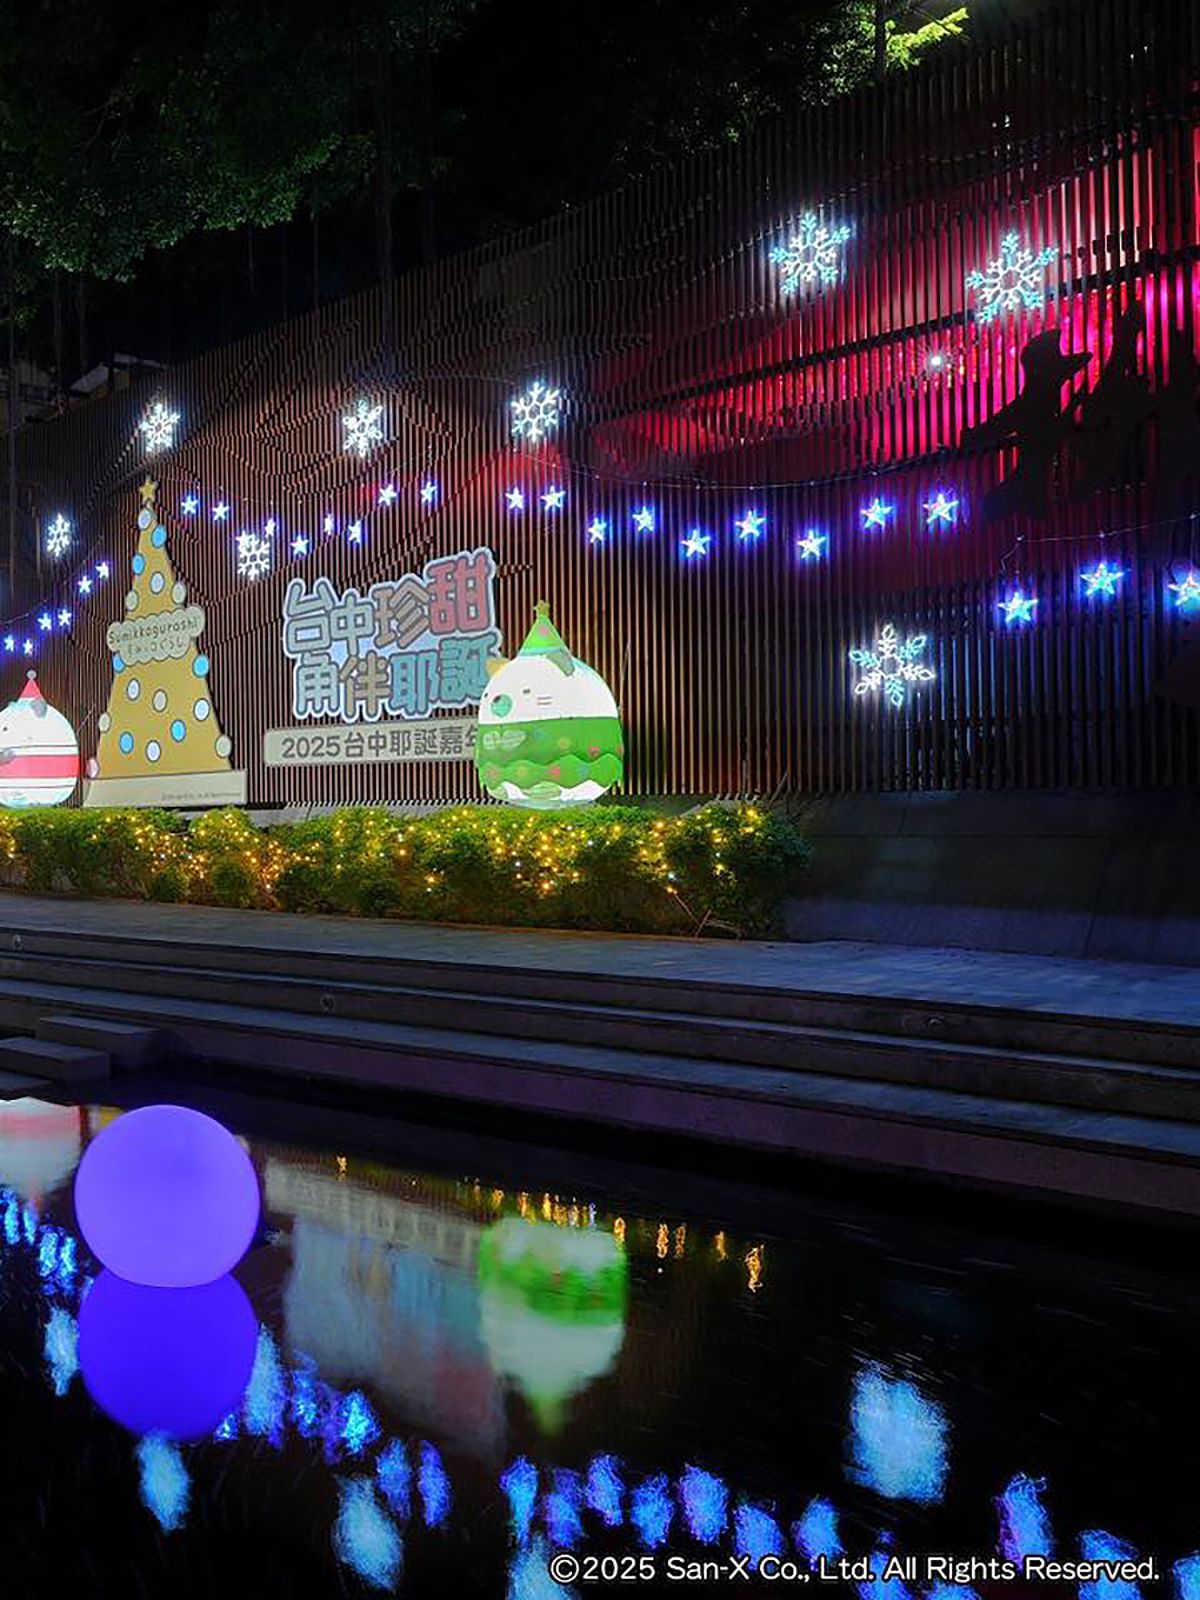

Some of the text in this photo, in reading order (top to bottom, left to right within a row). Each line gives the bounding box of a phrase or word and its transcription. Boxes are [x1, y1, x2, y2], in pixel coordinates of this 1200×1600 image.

[286, 552, 490, 656] 台中珍甜
[296, 633, 497, 719] 角伴耶誕
